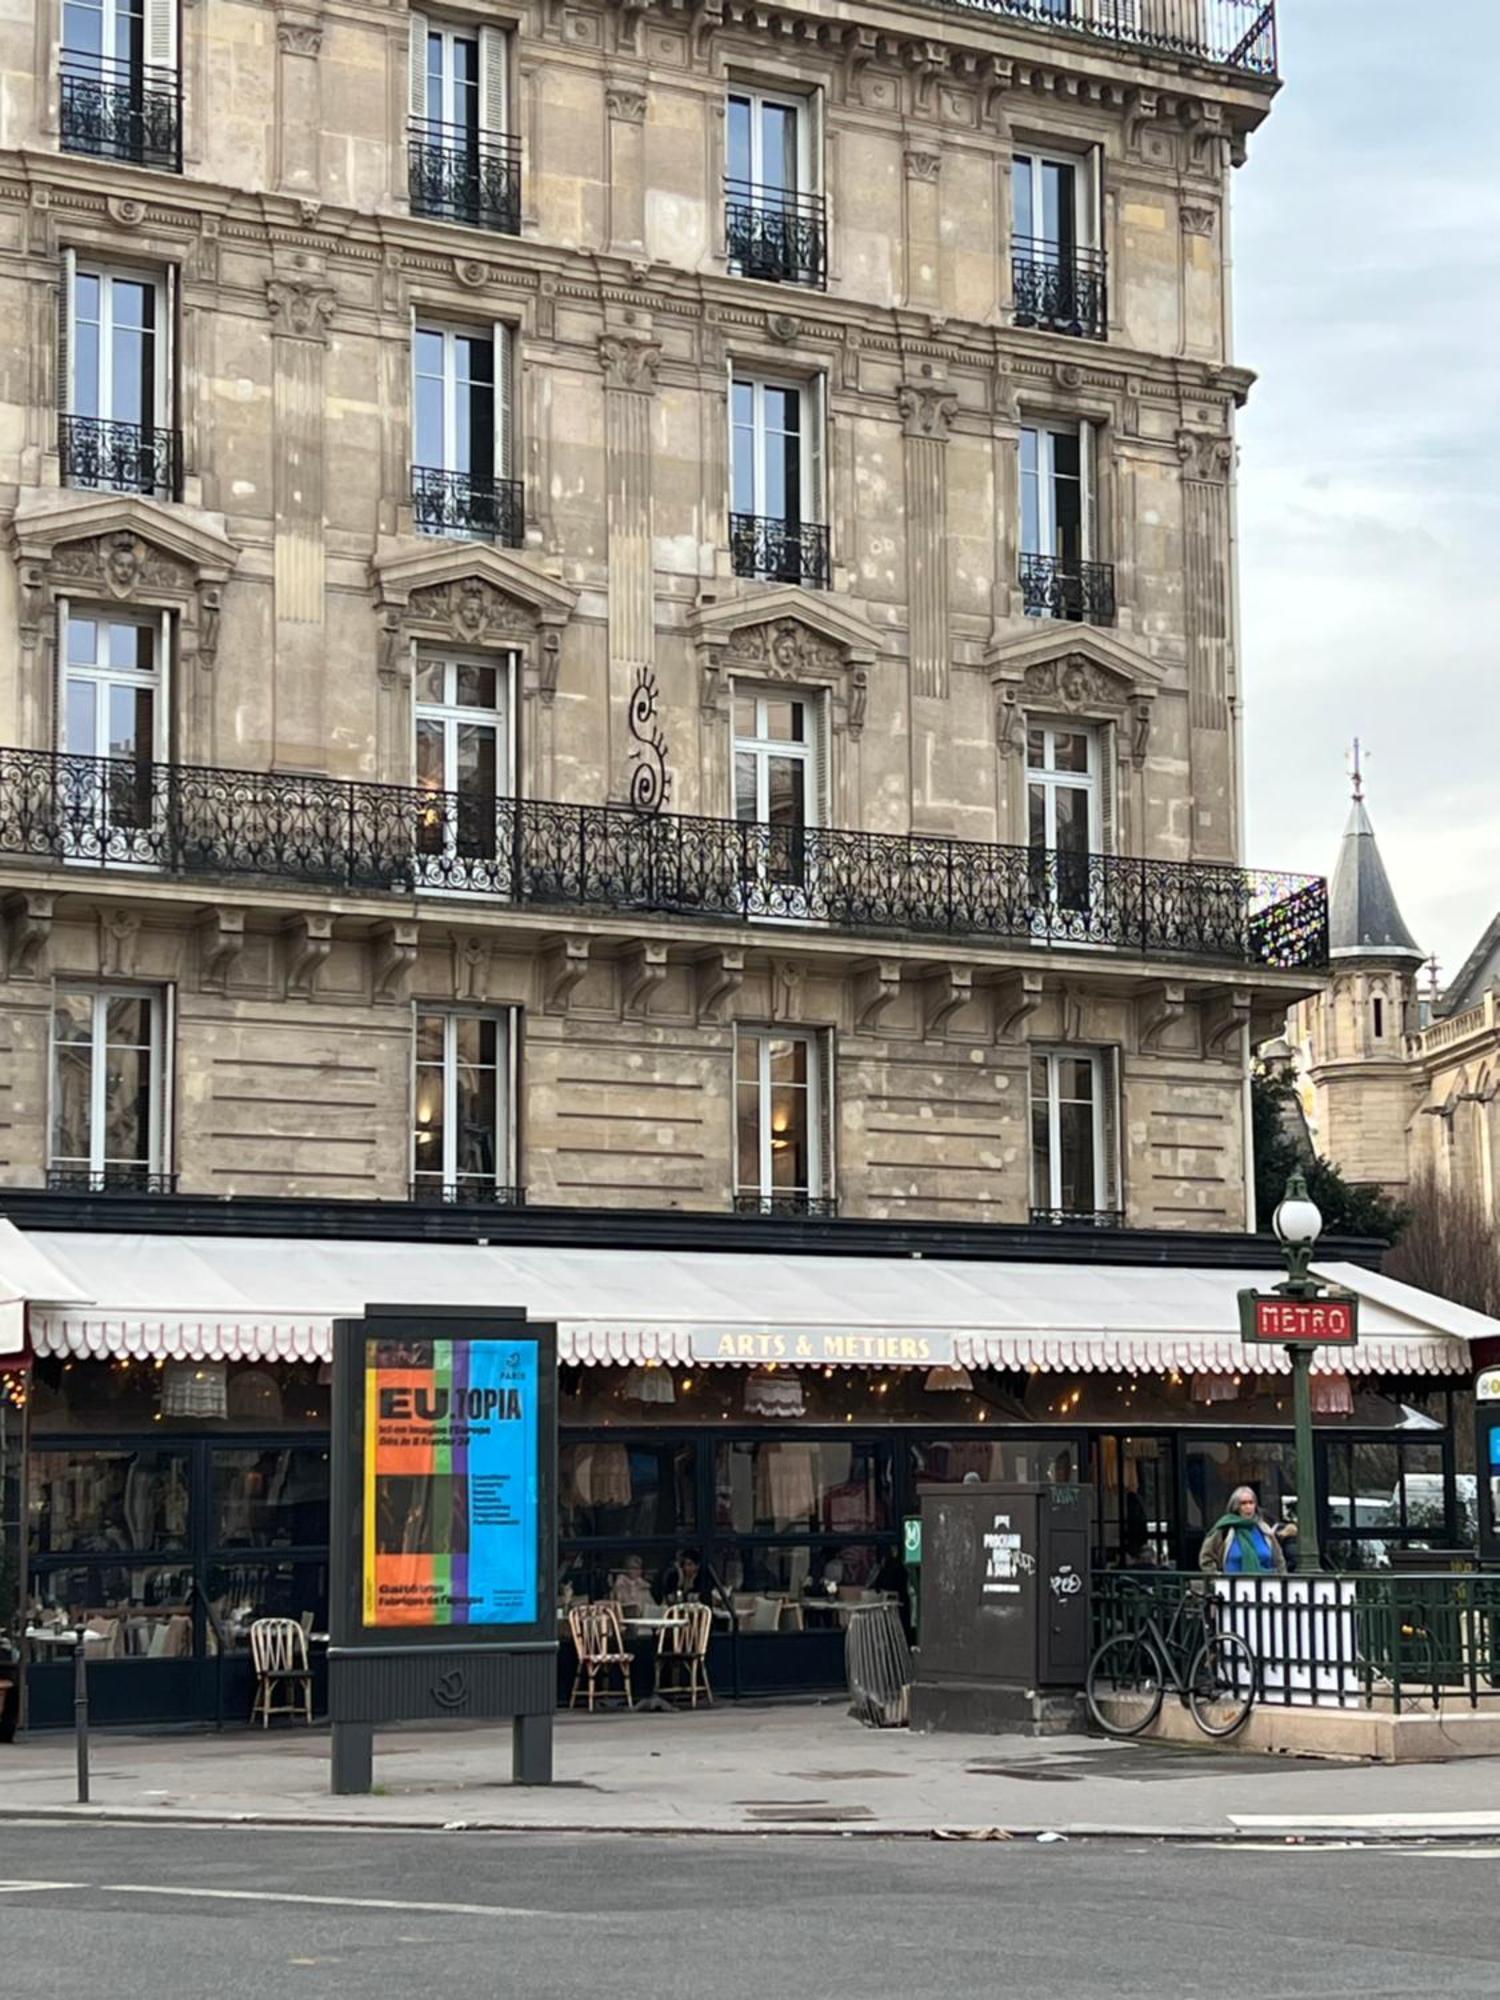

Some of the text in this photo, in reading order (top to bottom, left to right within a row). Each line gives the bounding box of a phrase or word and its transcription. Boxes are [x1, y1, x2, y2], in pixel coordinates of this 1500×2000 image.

[1262, 1306, 1345, 1333] METRO
[718, 1333, 787, 1356] ARTS
[796, 1335, 812, 1356] &
